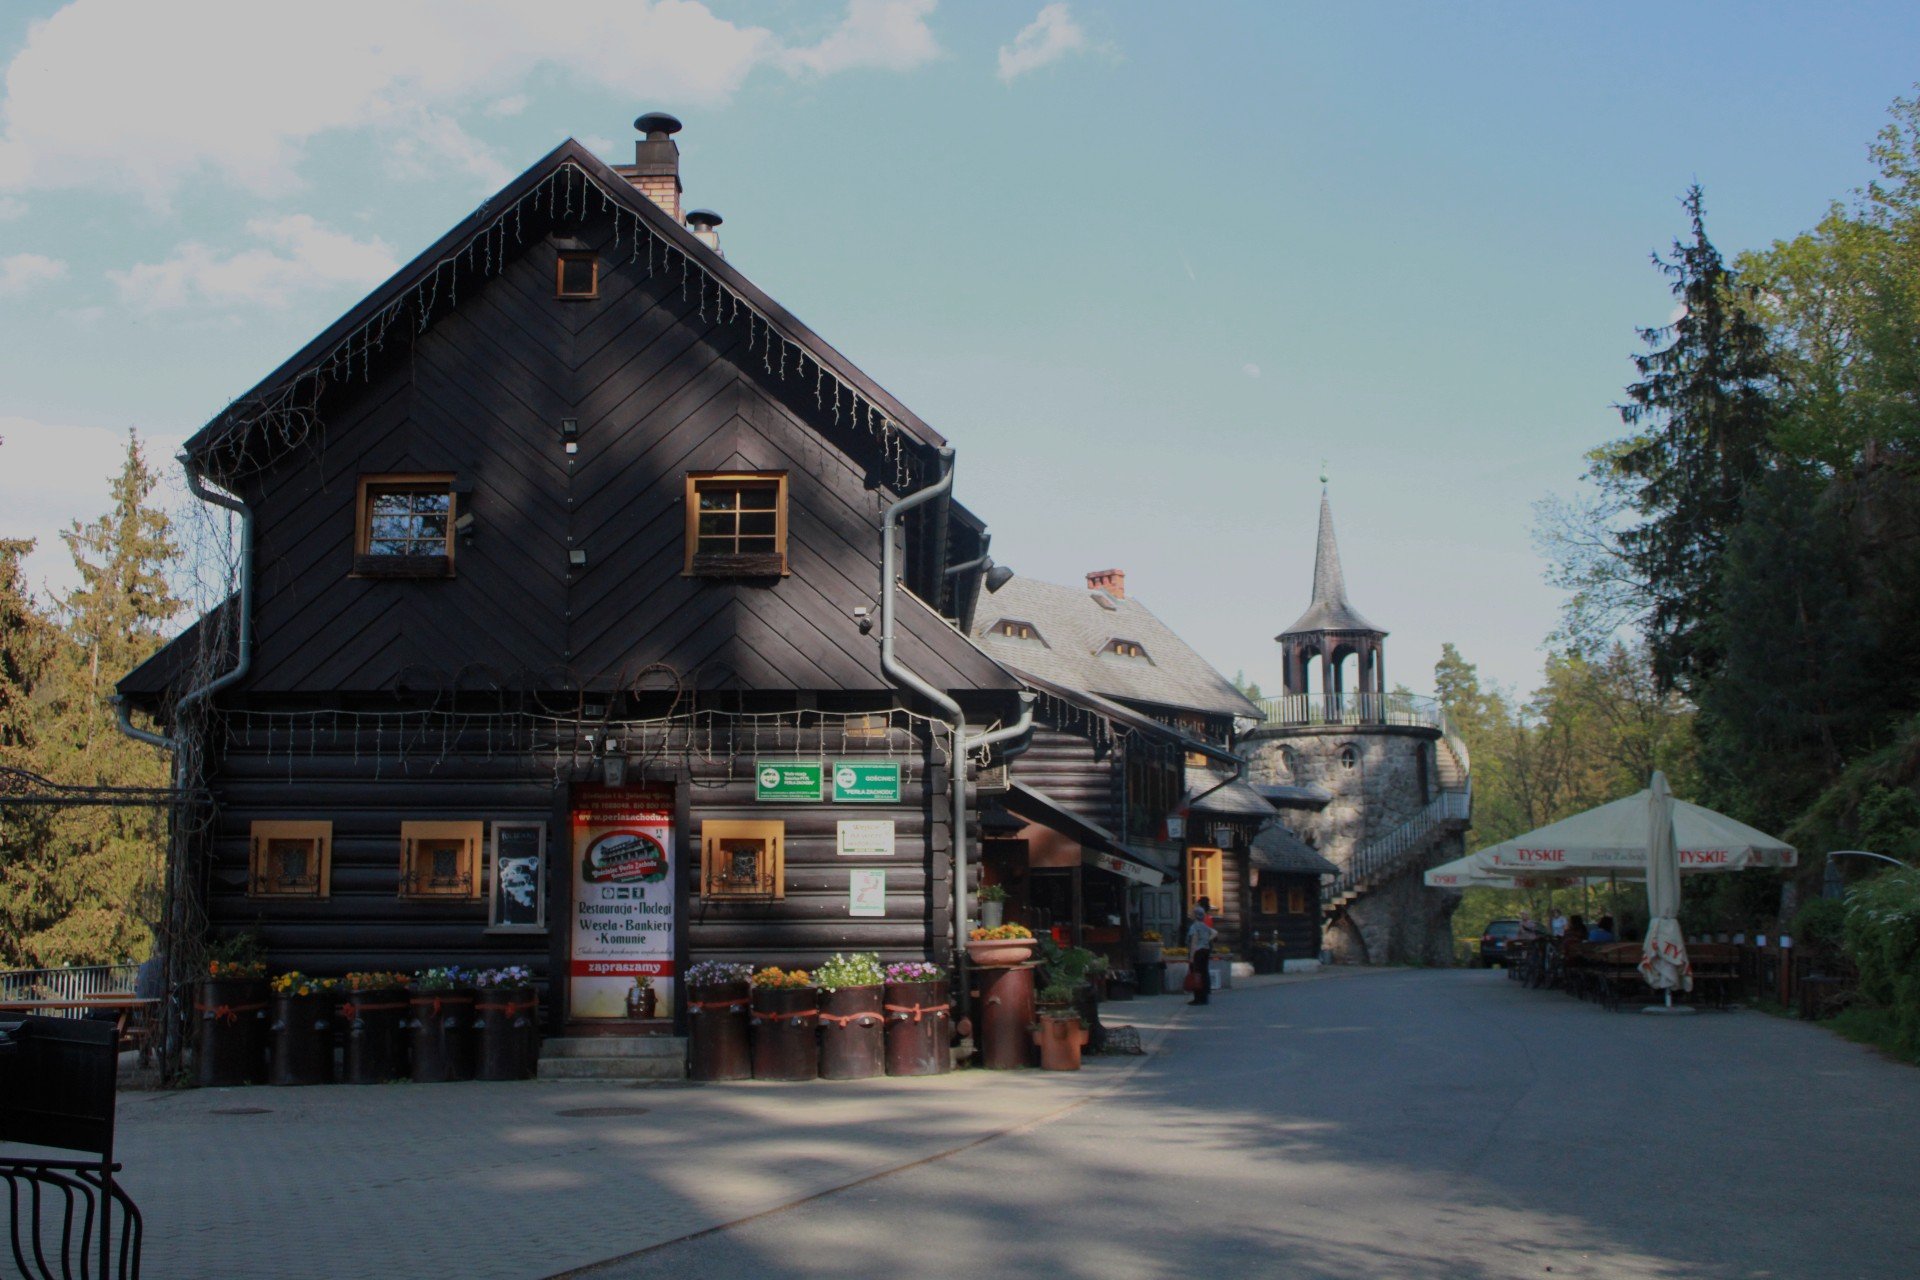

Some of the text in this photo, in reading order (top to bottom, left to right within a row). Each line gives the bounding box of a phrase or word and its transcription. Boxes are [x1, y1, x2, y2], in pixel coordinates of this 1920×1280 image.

[1517, 848, 1566, 862] TYSKIE
[1677, 850, 1728, 863] TYSKIE
[578, 902, 672, 915] Restauracja Noclegi
[579, 919, 673, 932] Wesela Bankiety
[600, 932, 646, 944] Komunie
[588, 963, 662, 974] zapraszamy
